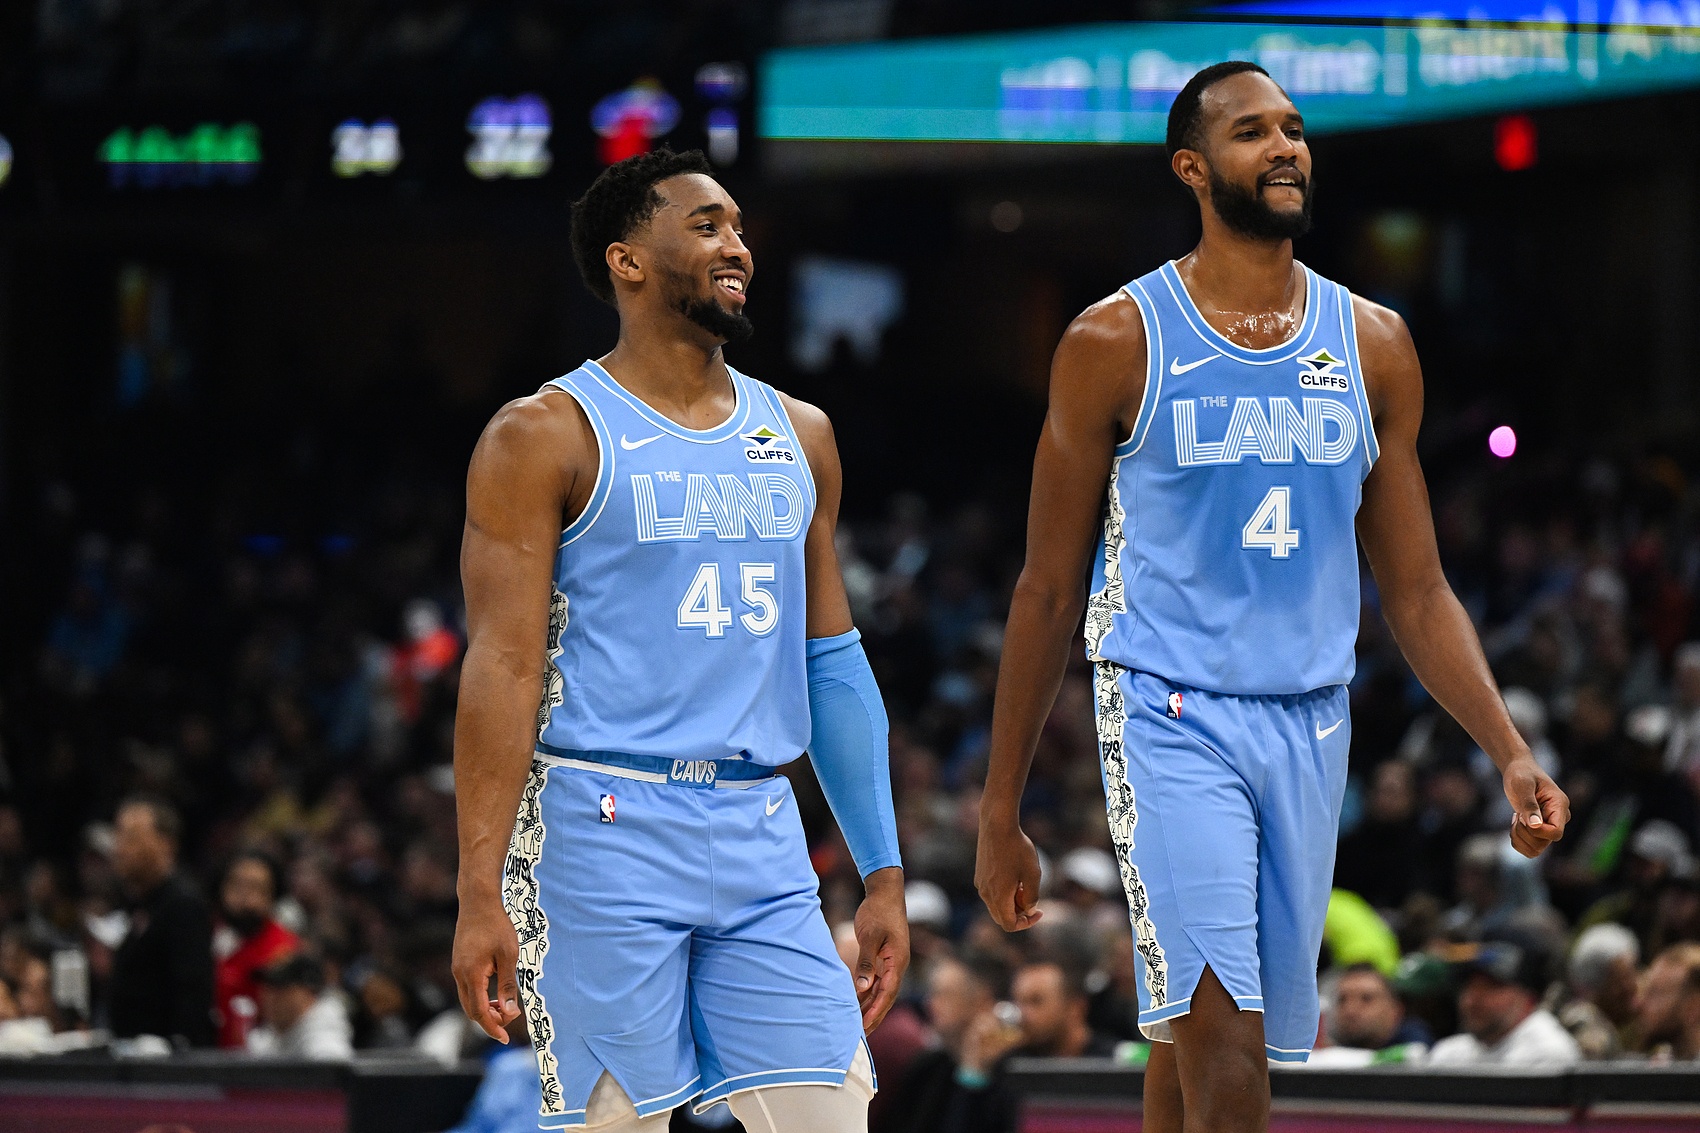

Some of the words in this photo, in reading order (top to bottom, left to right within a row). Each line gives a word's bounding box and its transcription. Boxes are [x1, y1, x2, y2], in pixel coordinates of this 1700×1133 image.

[1300, 374, 1348, 389] CLIFFS
[1199, 396, 1228, 408] THE
[1172, 397, 1358, 466] LAND
[746, 449, 794, 462] CLIFFS
[655, 470, 682, 482] THE
[630, 473, 805, 542] LAND
[1242, 486, 1299, 558] 4
[677, 562, 779, 637] 45
[670, 758, 717, 784] CAVS
